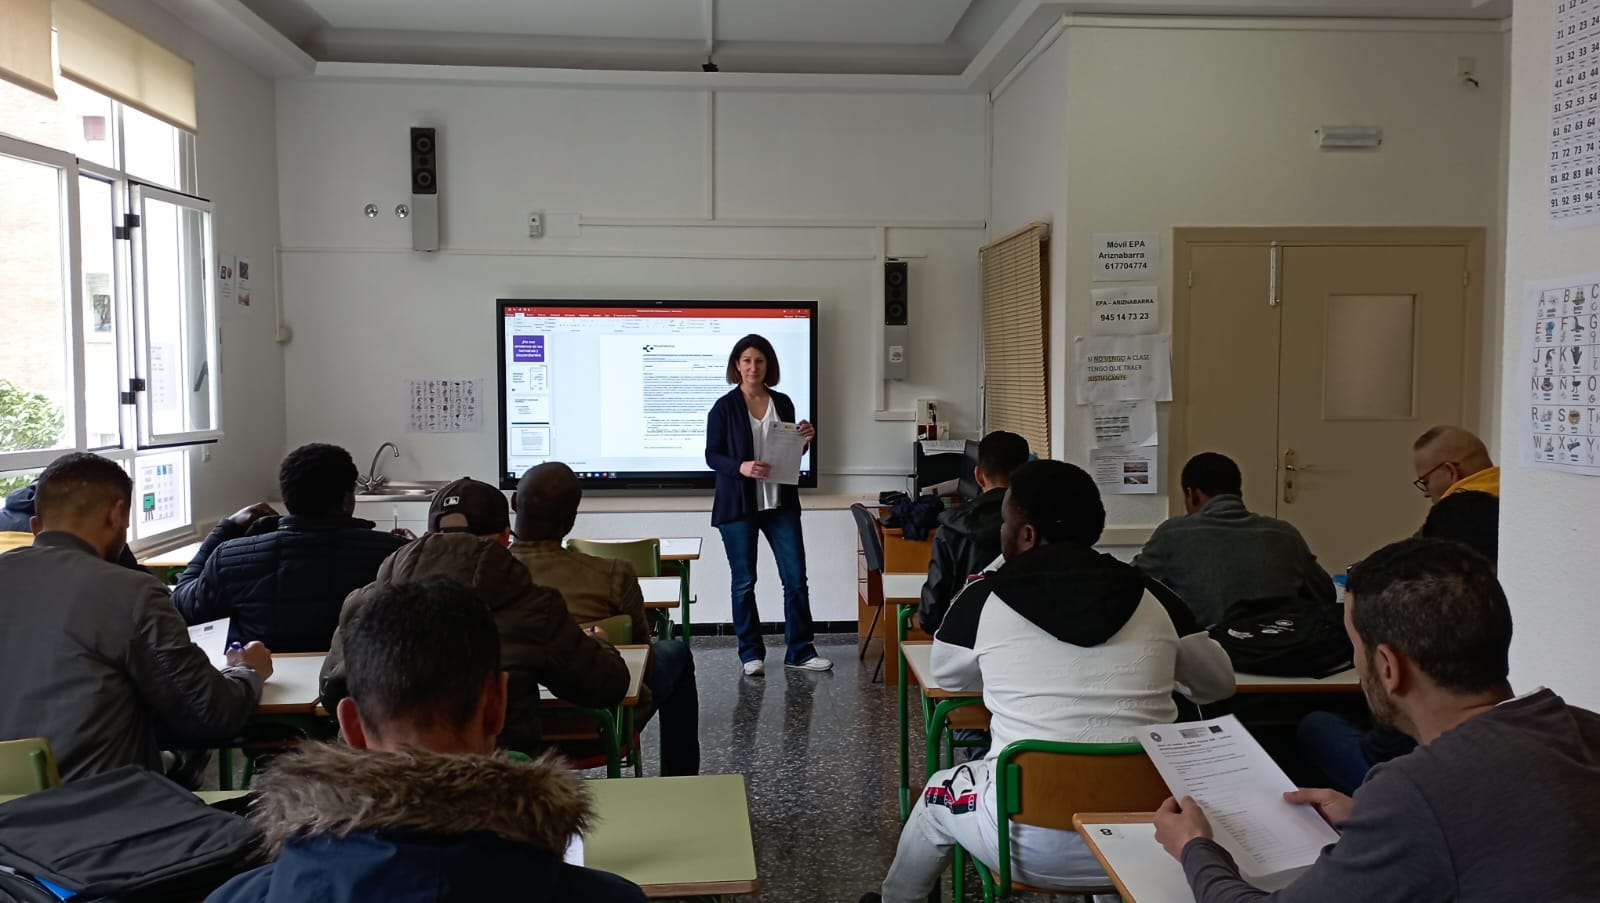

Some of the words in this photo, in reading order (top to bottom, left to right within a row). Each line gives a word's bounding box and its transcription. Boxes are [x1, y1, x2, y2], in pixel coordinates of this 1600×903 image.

[1558, 4, 1565, 14] 11
[1557, 30, 1564, 40] 21
[1568, 25, 1576, 35] 22
[1580, 20, 1588, 30] 23
[1592, 16, 1600, 26] 24
[1556, 56, 1563, 64] 31
[1567, 51, 1574, 61] 32
[1579, 46, 1587, 56] 33
[1591, 42, 1600, 52] 34
[1555, 80, 1562, 88] 41
[1566, 75, 1574, 84] 42
[1578, 72, 1586, 80] 43
[1590, 67, 1598, 76] 44
[1554, 104, 1561, 112] 51
[1565, 100, 1572, 110] 52
[1576, 96, 1584, 106] 53
[1589, 92, 1598, 102] 54
[1553, 128, 1560, 136] 61
[1564, 124, 1572, 134] 62
[1575, 120, 1583, 130] 63
[1587, 117, 1596, 127] 64
[1552, 152, 1558, 160] 71
[1562, 148, 1570, 158] 72
[1574, 146, 1582, 155] 73
[1586, 142, 1594, 152] 74
[1550, 176, 1558, 184] 81
[1562, 172, 1569, 181] 82
[1573, 170, 1581, 180] 83
[1585, 168, 1593, 176] 84
[1551, 198, 1558, 207] 91
[1562, 196, 1569, 206] 92
[1573, 194, 1580, 203] 93
[1584, 192, 1592, 201] 94
[1106, 240, 1126, 248] Móvil
[1538, 292, 1545, 306] A
[1564, 289, 1570, 302] B
[1592, 284, 1600, 299] C
[1536, 322, 1542, 334] E
[1560, 317, 1568, 330] F
[1590, 314, 1598, 330] G
[1532, 348, 1540, 364] J
[1560, 346, 1567, 362] K
[1532, 377, 1539, 391] N
[1588, 376, 1596, 392] O
[1531, 407, 1538, 422] R
[1558, 408, 1566, 422] S
[1588, 408, 1596, 422] T
[1533, 435, 1542, 448] W
[1558, 436, 1566, 450] X
[1587, 438, 1594, 452] Y
